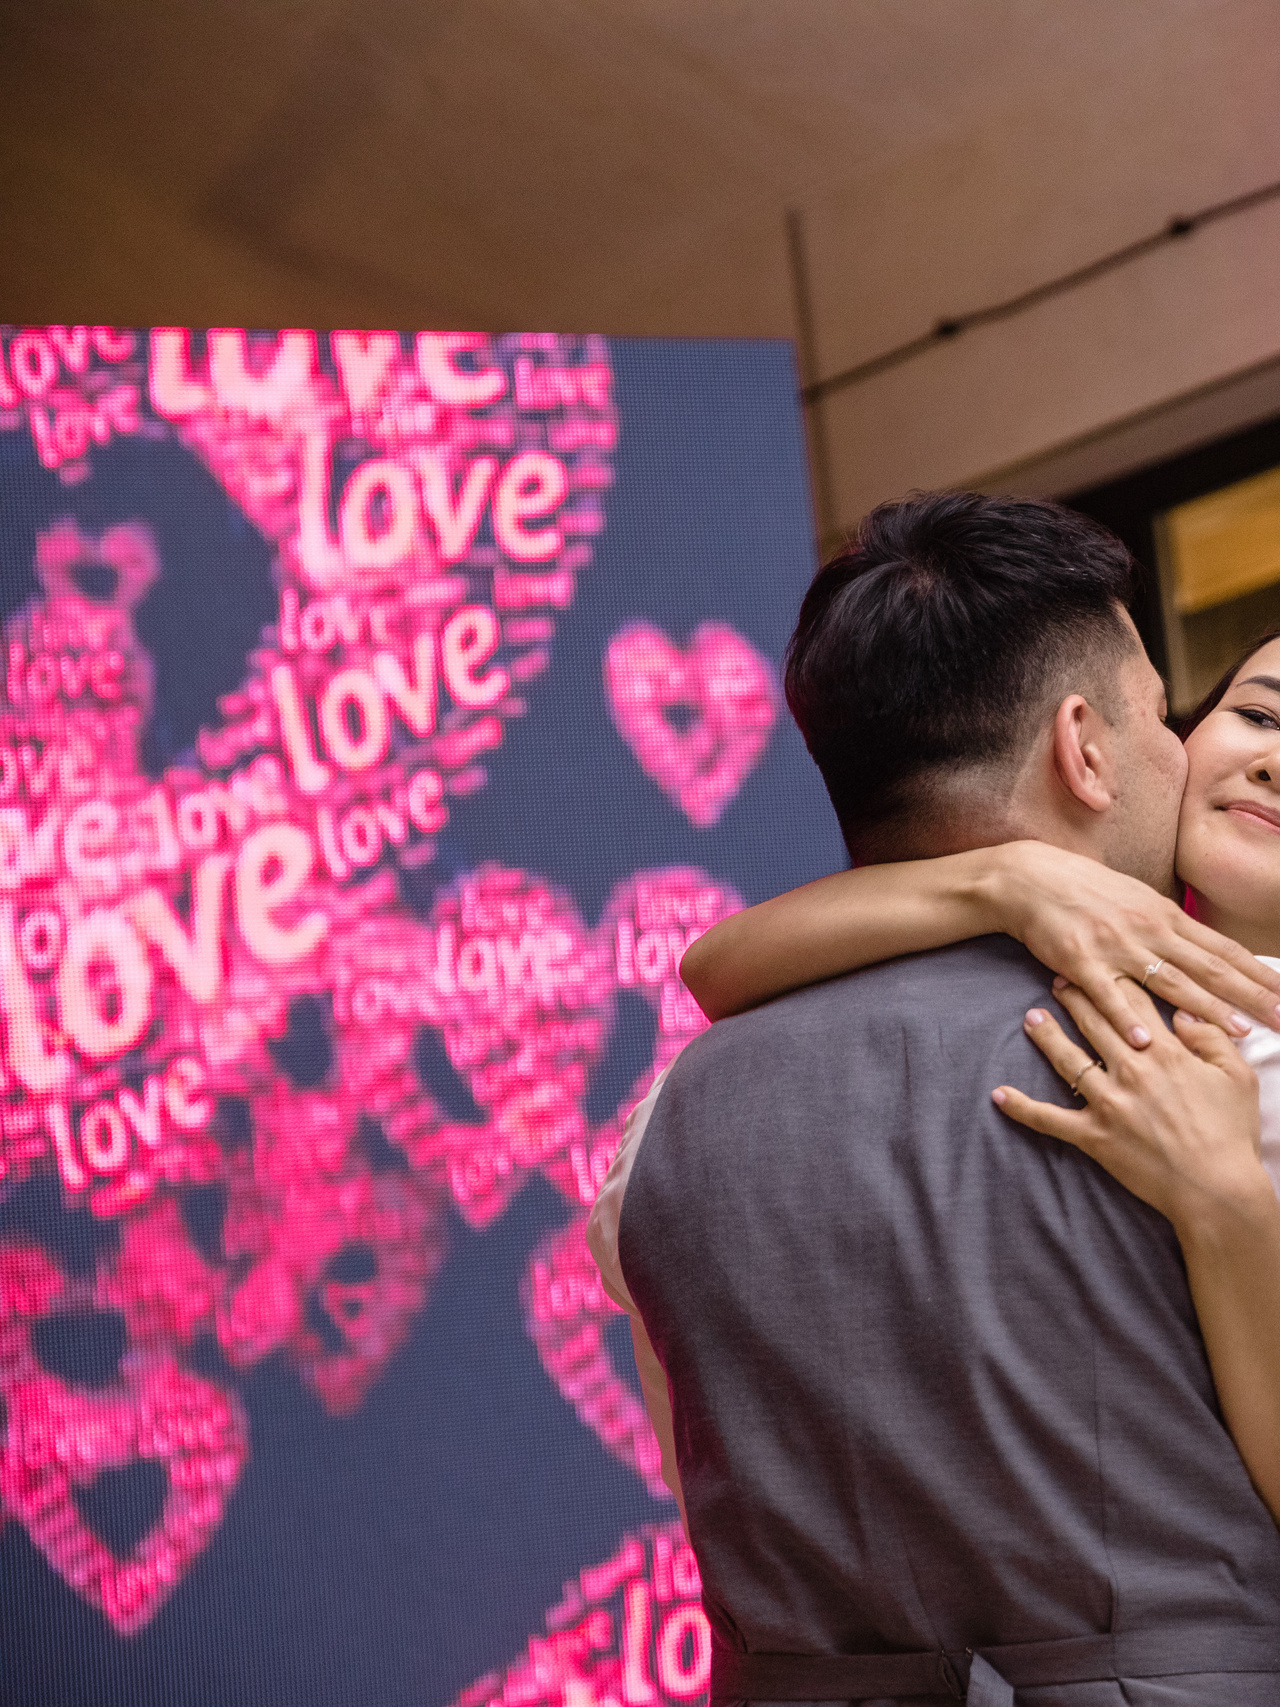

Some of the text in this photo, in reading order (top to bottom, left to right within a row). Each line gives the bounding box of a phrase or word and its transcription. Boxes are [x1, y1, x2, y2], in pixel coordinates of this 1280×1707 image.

[298, 428, 569, 590] love
[270, 604, 511, 793] love
[316, 770, 446, 882] love
[0, 820, 332, 1097] love
[47, 1055, 214, 1194] love
